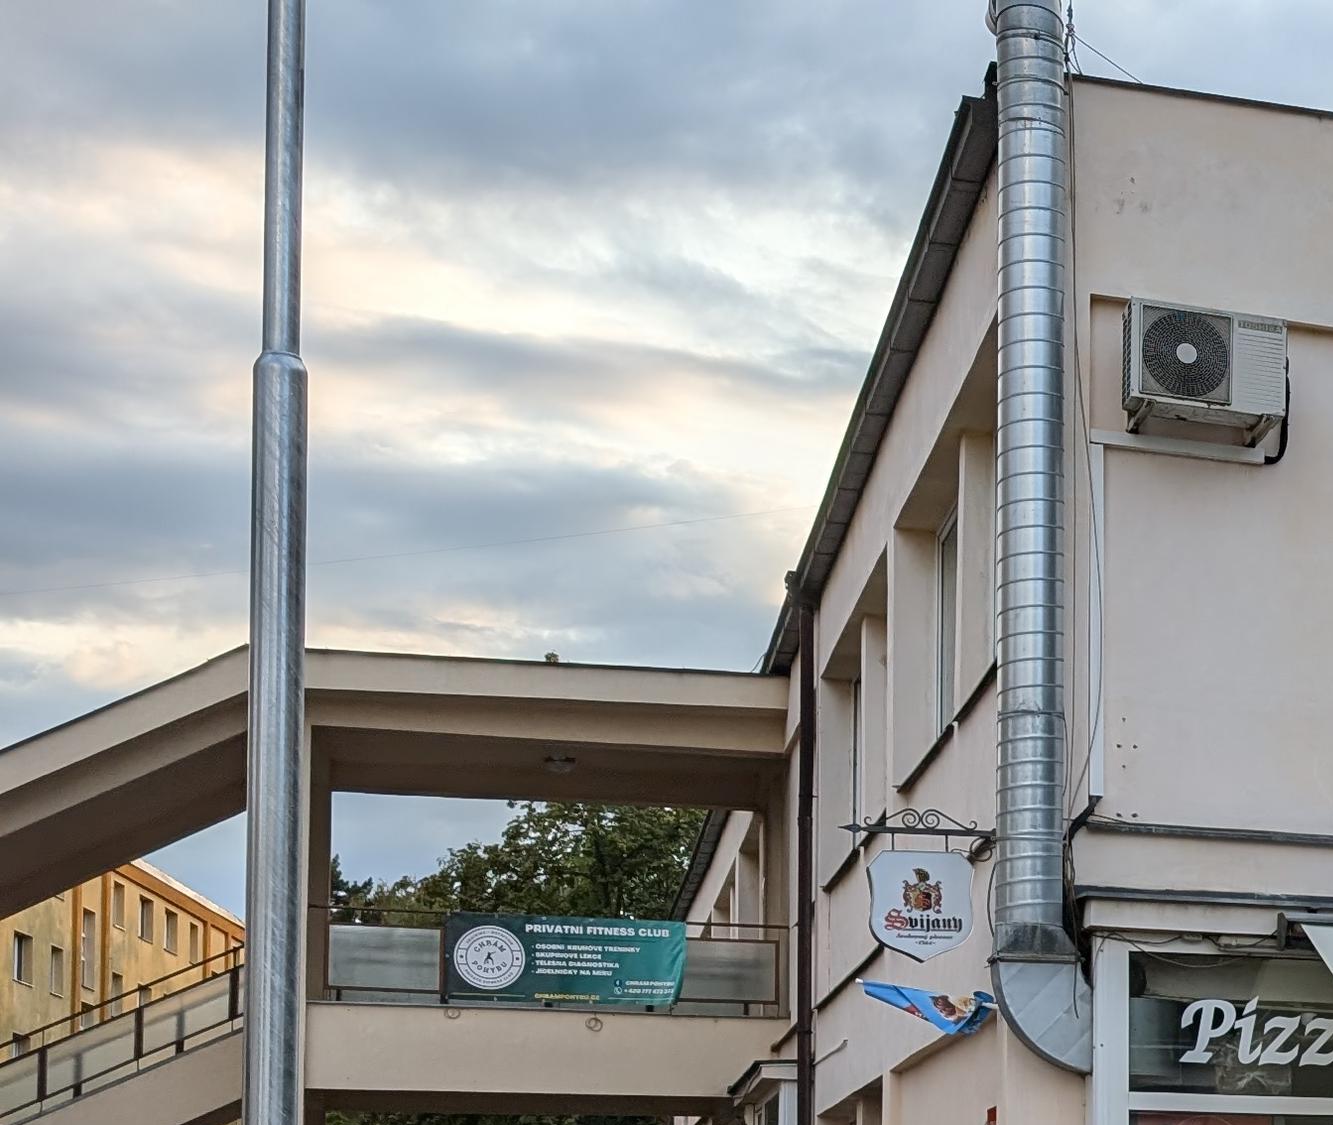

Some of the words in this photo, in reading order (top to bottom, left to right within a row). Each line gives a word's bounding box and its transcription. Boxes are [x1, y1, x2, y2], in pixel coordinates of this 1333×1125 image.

[885, 908, 963, 933] Svijany
[587, 926, 635, 936] FITNESS
[638, 928, 670, 937] CLUB
